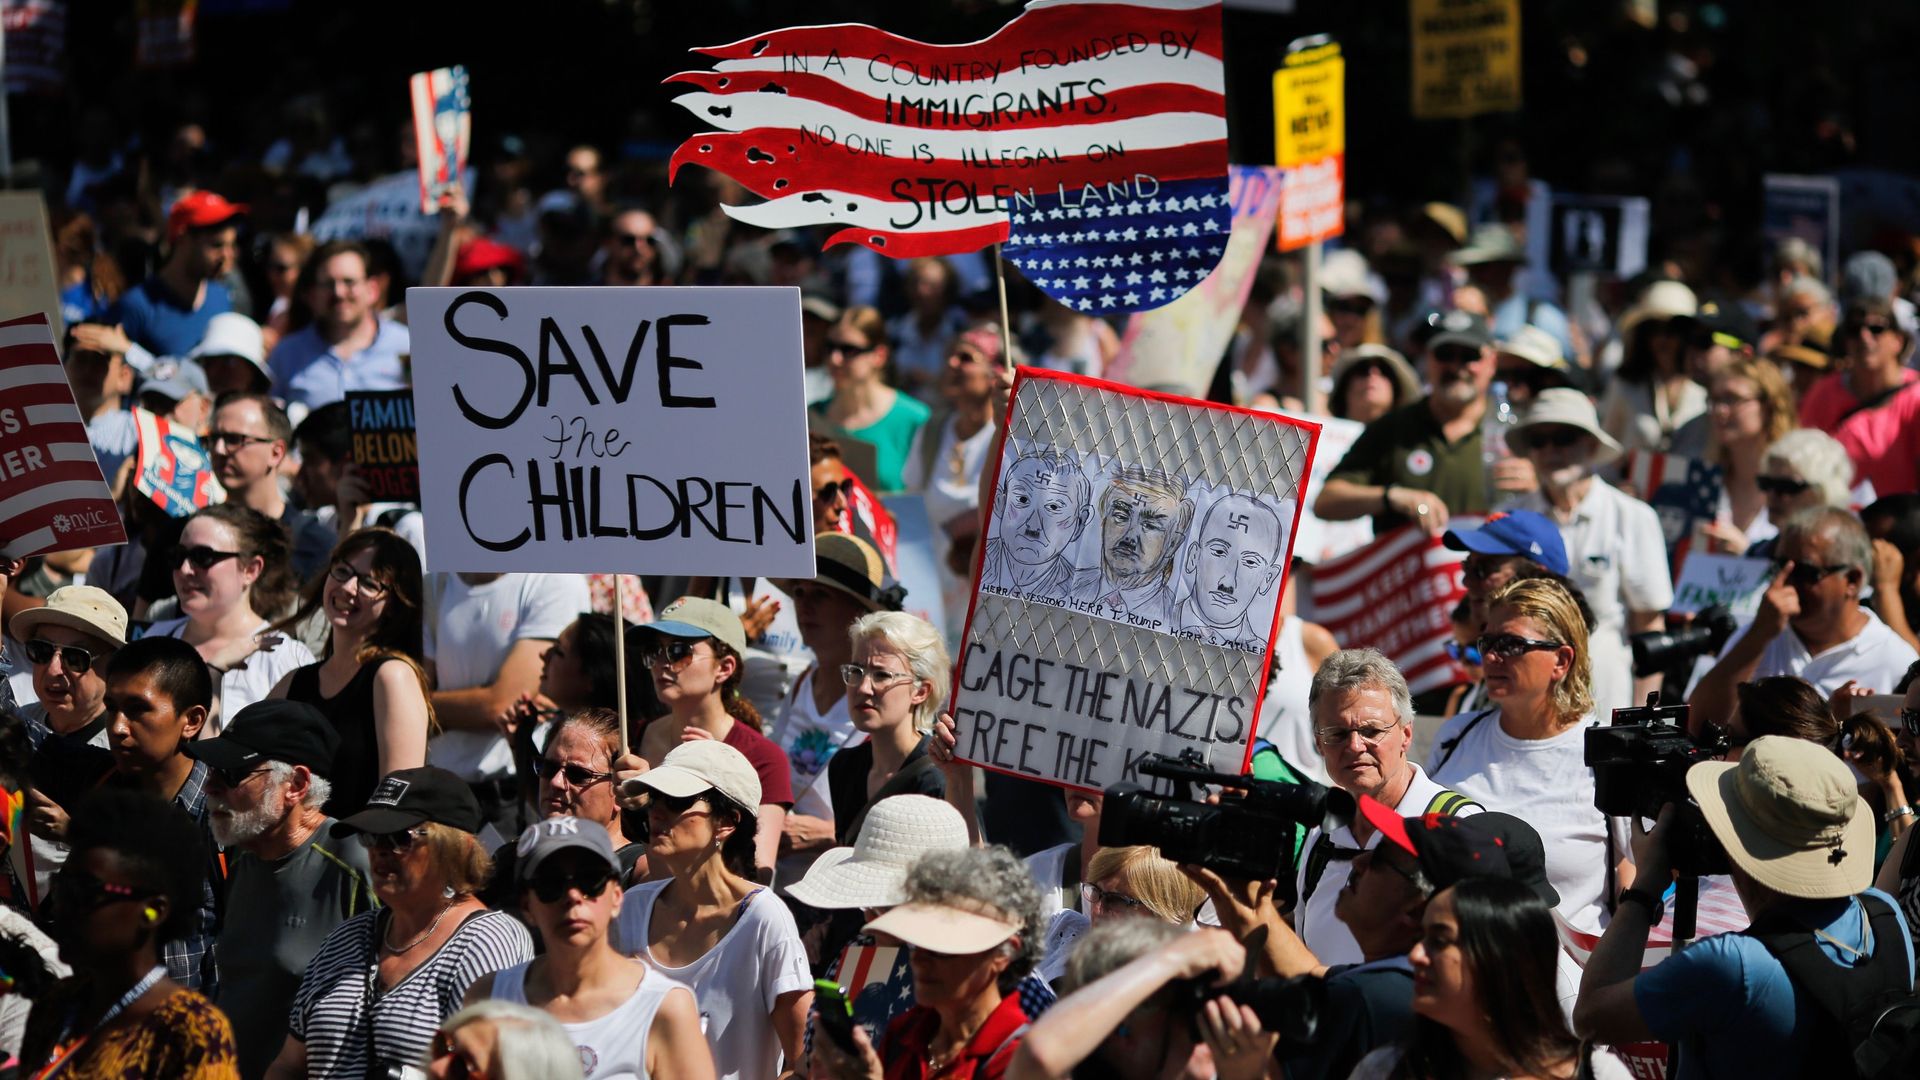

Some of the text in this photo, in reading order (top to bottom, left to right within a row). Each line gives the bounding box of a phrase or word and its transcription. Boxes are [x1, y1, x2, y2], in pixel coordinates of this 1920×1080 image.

[783, 30, 1199, 85] IN A COUNTRY FOUNDED BY
[885, 78, 1118, 127] IMMIGRANTS,
[800, 125, 1126, 168] NO ONE IS ILLEGAL ON
[890, 173, 1160, 229] STOLEN LAND
[444, 291, 717, 430] SAVE
[543, 415, 632, 460] the
[459, 453, 806, 552] CHILDREN
[982, 583, 1008, 597] HERR
[1069, 596, 1104, 617] HERR
[1350, 572, 1452, 637] FAMILIES
[1366, 554, 1422, 605] KEEP
[960, 642, 1247, 745] CAGE THE NAZIS.
[953, 707, 1046, 775] FREE
[1054, 731, 1108, 787] THE
